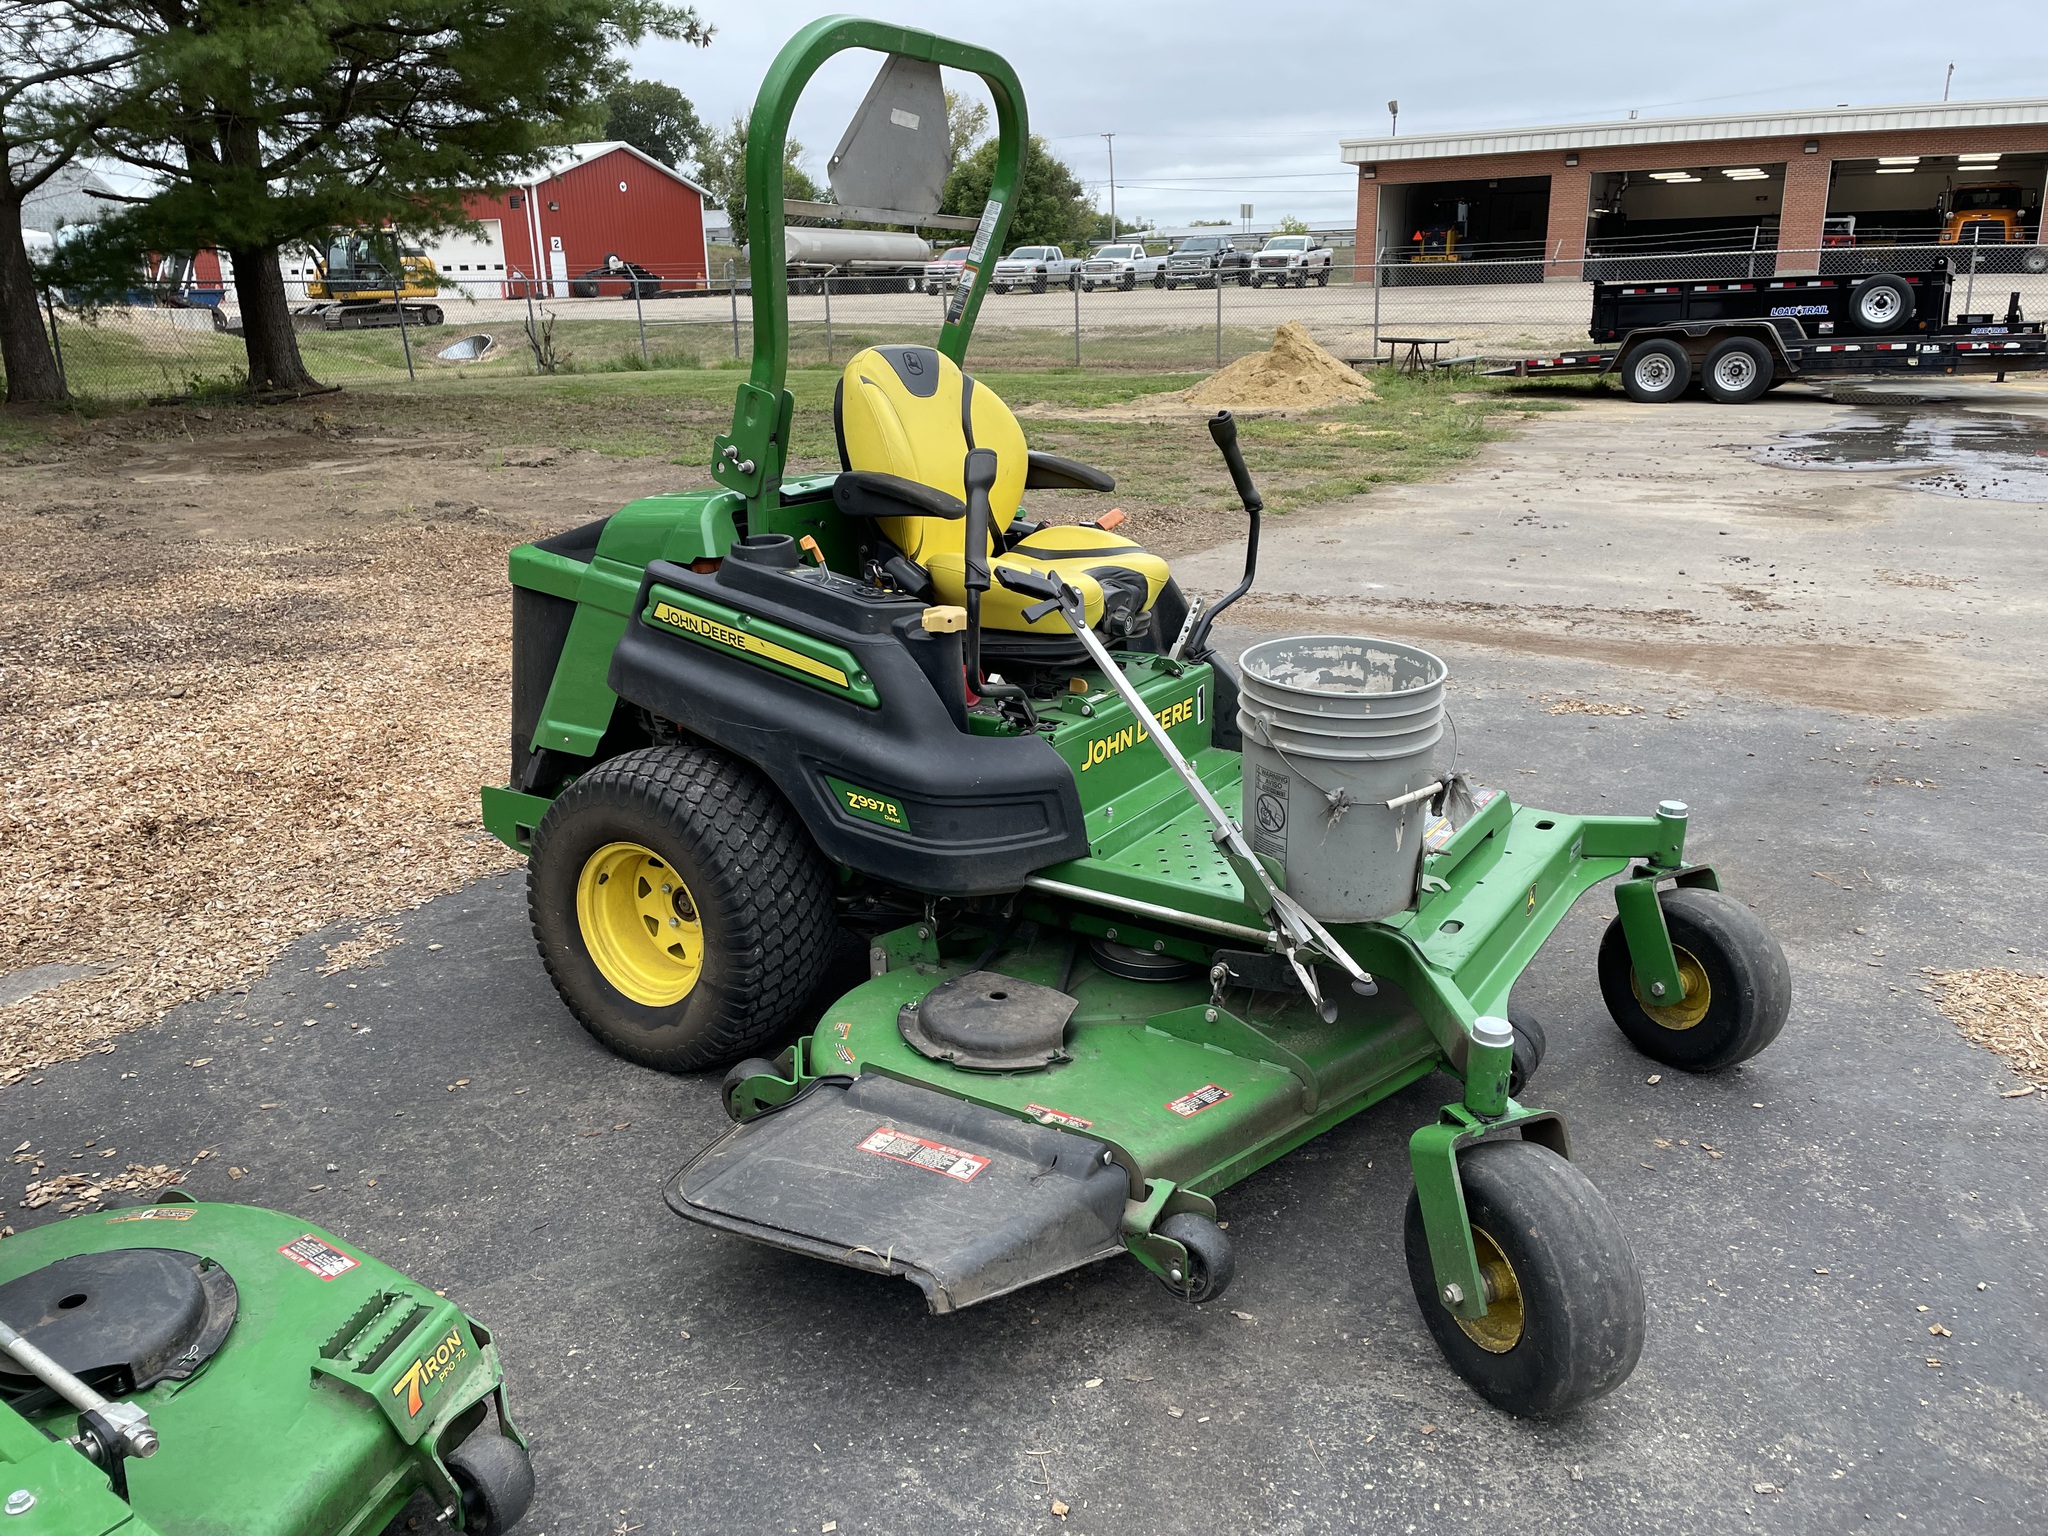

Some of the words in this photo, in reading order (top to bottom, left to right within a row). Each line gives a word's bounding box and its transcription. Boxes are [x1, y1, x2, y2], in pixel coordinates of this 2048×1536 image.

[553, 238, 561, 249] 2
[1770, 307, 1797, 317] LOAD
[1801, 305, 1829, 315] TRAIL
[663, 607, 699, 631] JOHN
[700, 619, 747, 649] DEERE
[1081, 725, 1133, 772] JOHN
[1136, 697, 1194, 744] DERE
[455, 1348, 467, 1363] 72
